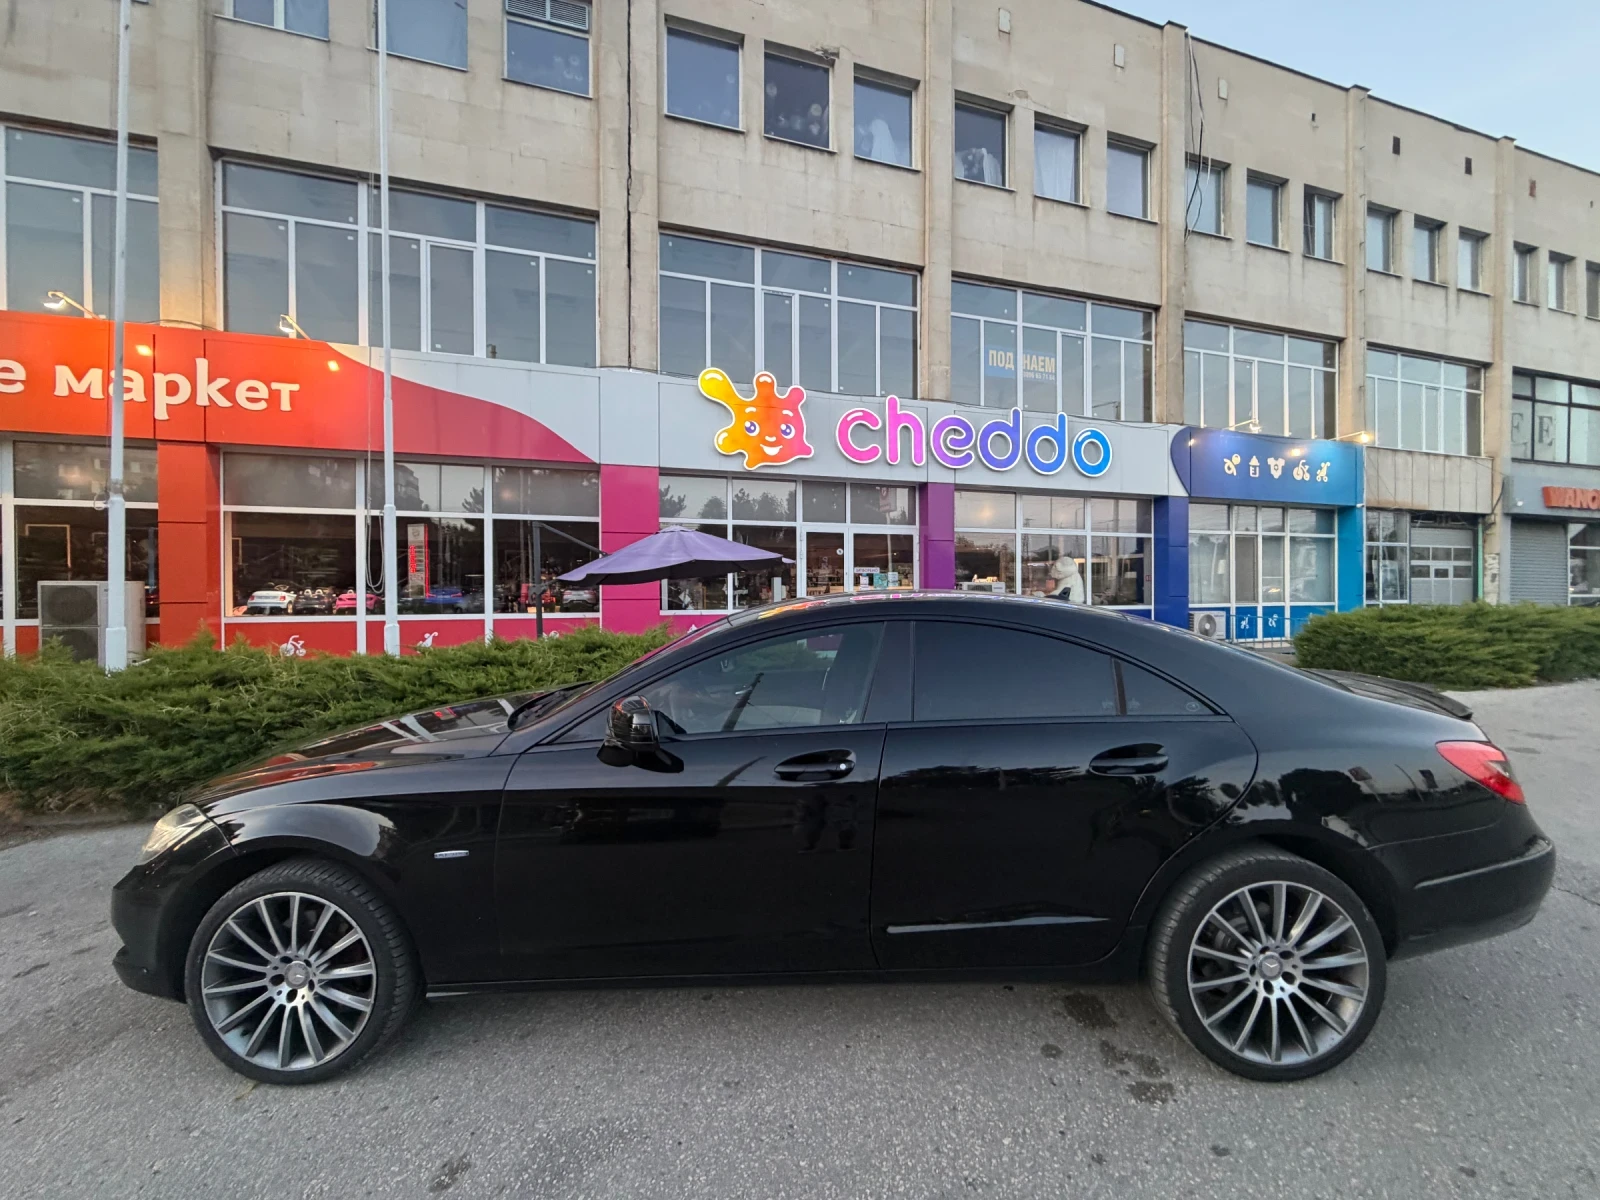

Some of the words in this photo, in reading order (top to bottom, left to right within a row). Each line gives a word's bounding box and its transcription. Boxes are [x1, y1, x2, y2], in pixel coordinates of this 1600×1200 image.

[53, 357, 300, 421] маркет
[988, 349, 1015, 371] ПОД
[1023, 353, 1056, 373] НАЕМ
[835, 394, 1113, 477] cheddo
